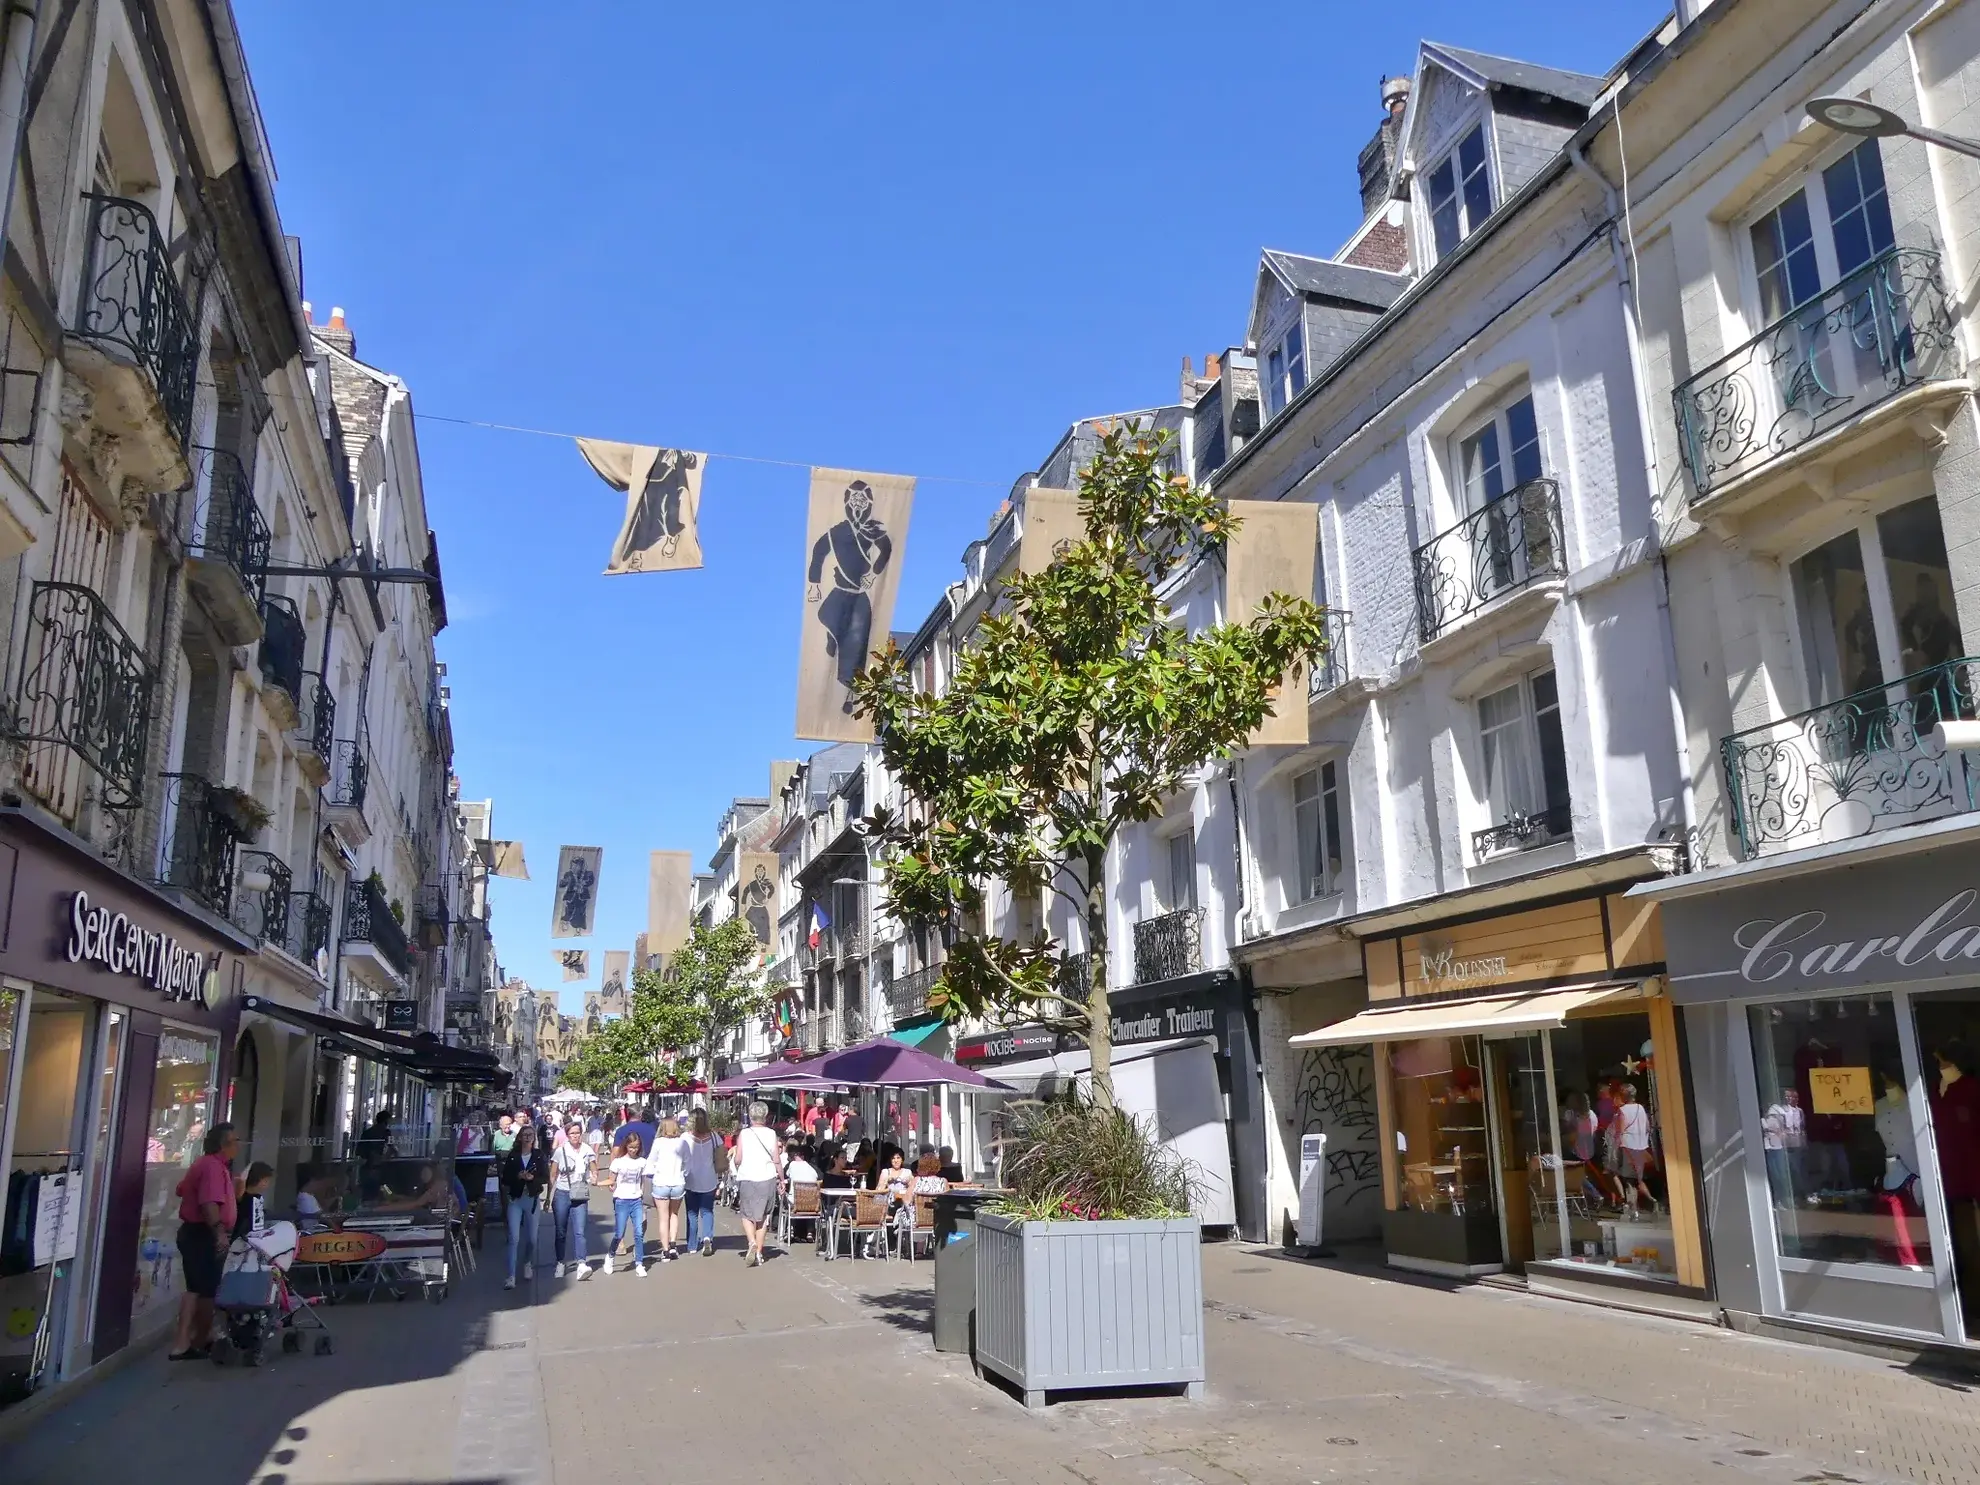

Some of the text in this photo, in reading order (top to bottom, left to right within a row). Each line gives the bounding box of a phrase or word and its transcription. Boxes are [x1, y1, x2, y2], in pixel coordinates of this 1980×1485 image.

[1733, 888, 1980, 982] Carla
[1111, 1005, 1214, 1041] Charcutier Traiteur
[1815, 1074, 1851, 1085] TOUT
[1833, 1087, 1841, 1098] A
[313, 1238, 379, 1253] REGENT
